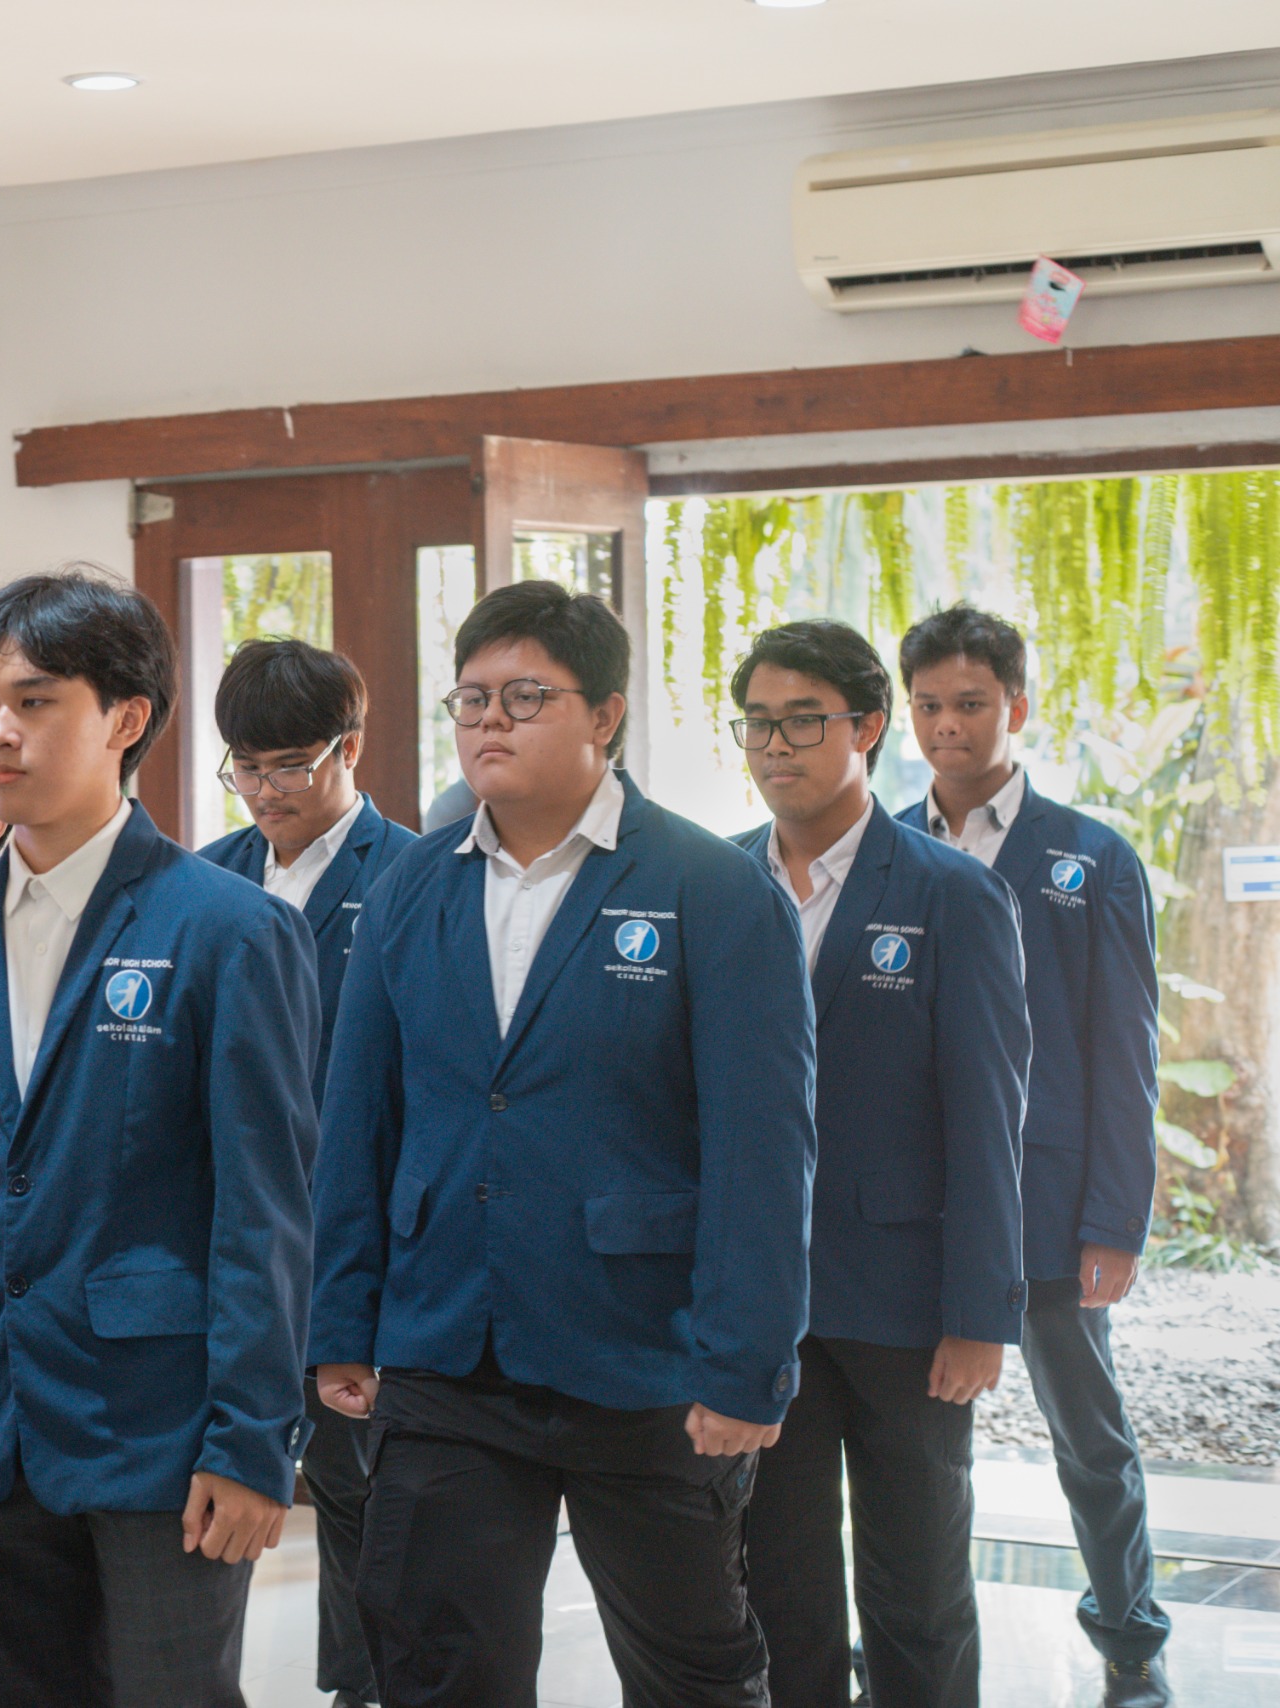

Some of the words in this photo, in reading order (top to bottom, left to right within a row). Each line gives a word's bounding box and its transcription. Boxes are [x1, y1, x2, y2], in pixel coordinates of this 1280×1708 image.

[647, 911, 678, 919] SCHOOL
[121, 959, 140, 968] HIGH
[141, 959, 174, 969] SCHOOL
